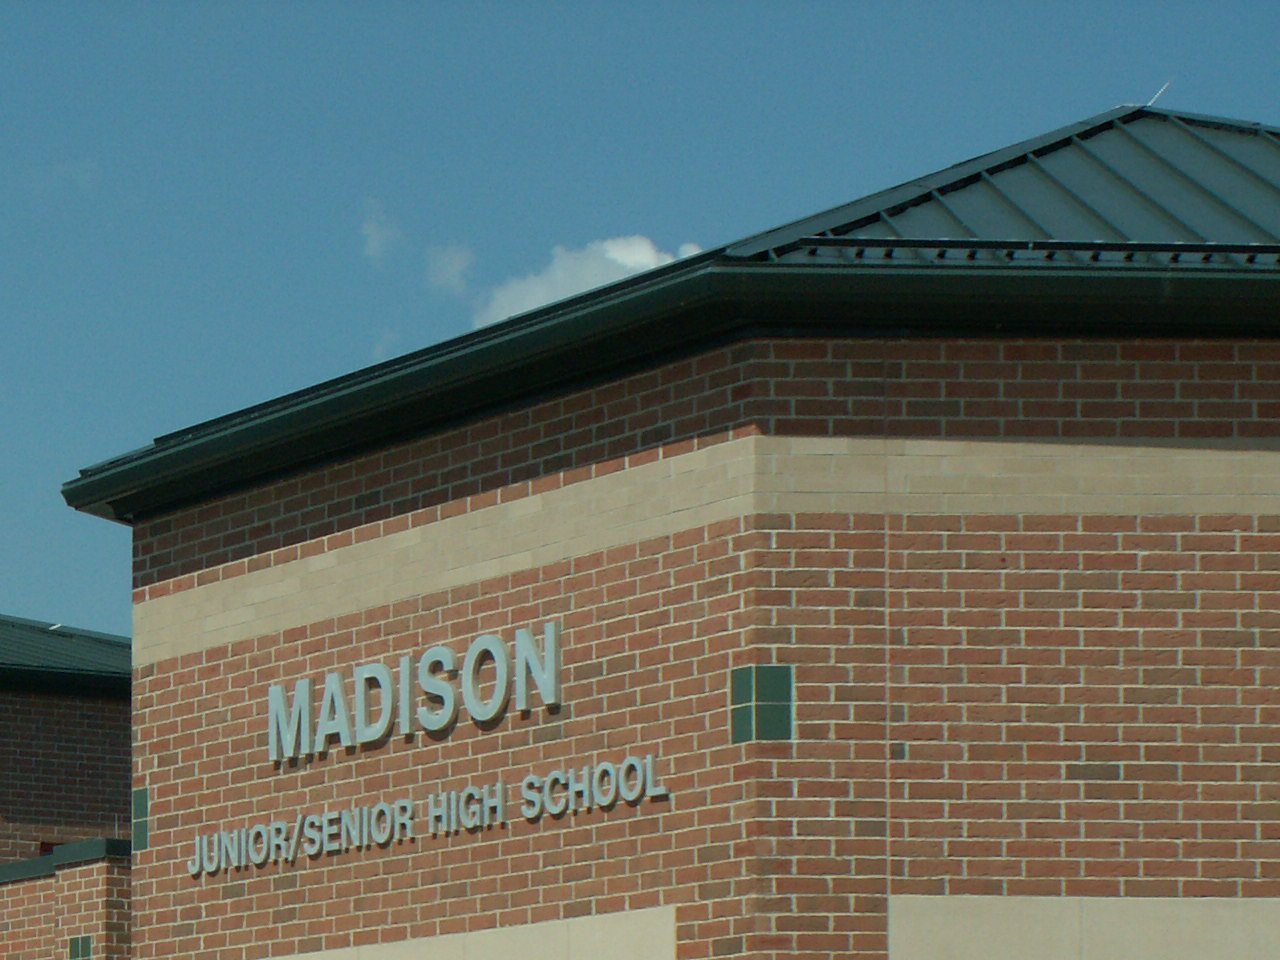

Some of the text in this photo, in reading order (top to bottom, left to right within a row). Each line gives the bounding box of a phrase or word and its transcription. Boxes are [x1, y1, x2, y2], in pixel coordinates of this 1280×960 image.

[267, 621, 561, 762] MADISON
[187, 754, 668, 876] JUNIOR/SENIOR HIGH SCHOOL
